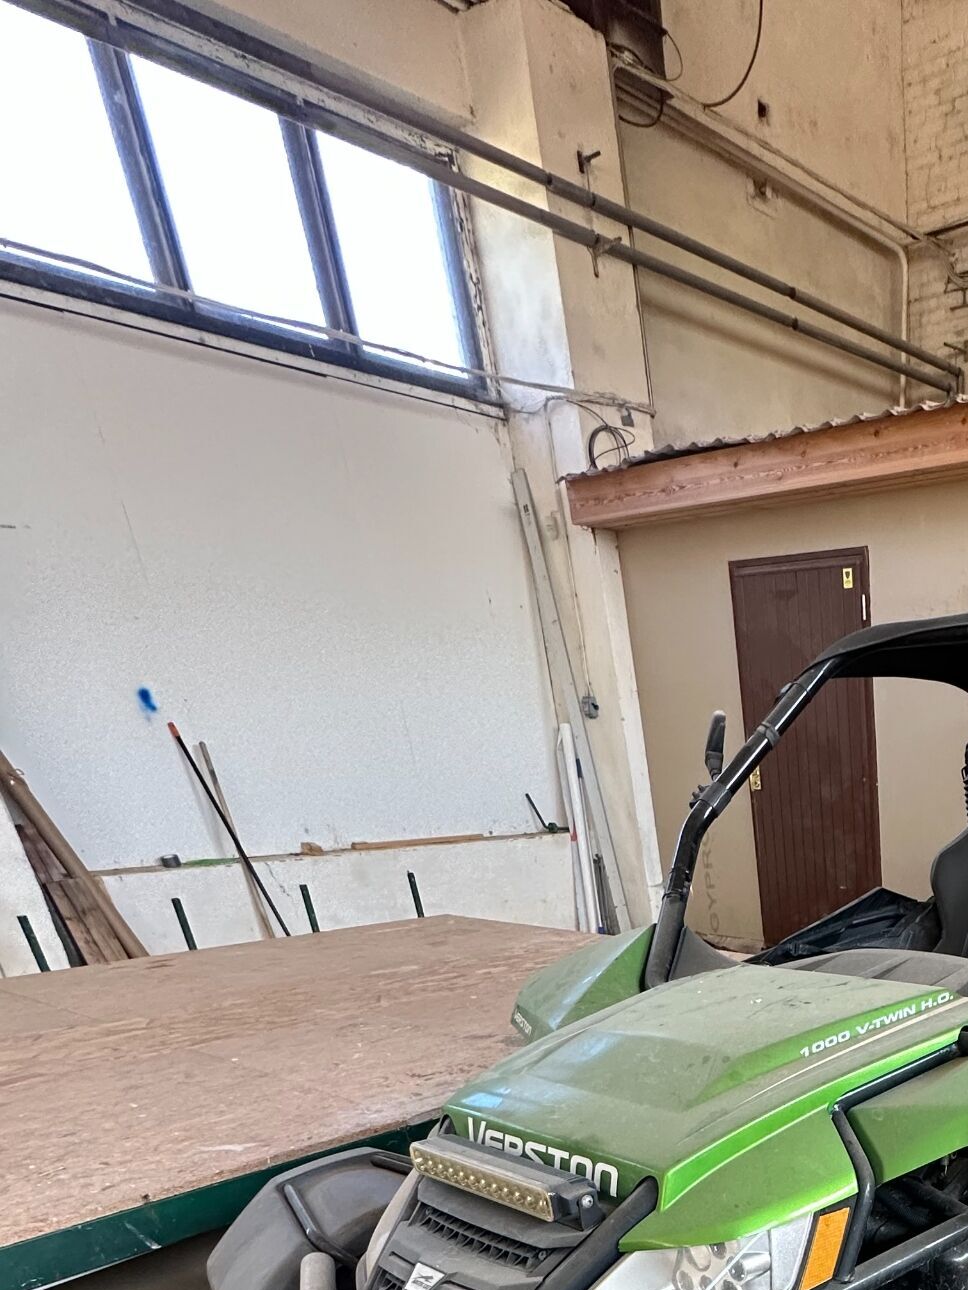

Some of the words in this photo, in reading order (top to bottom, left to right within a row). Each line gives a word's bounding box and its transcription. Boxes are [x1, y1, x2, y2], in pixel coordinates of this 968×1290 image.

[799, 1030, 850, 1058] 1000
[855, 1004, 917, 1035] V-TWIN
[920, 991, 954, 1011] H.O.
